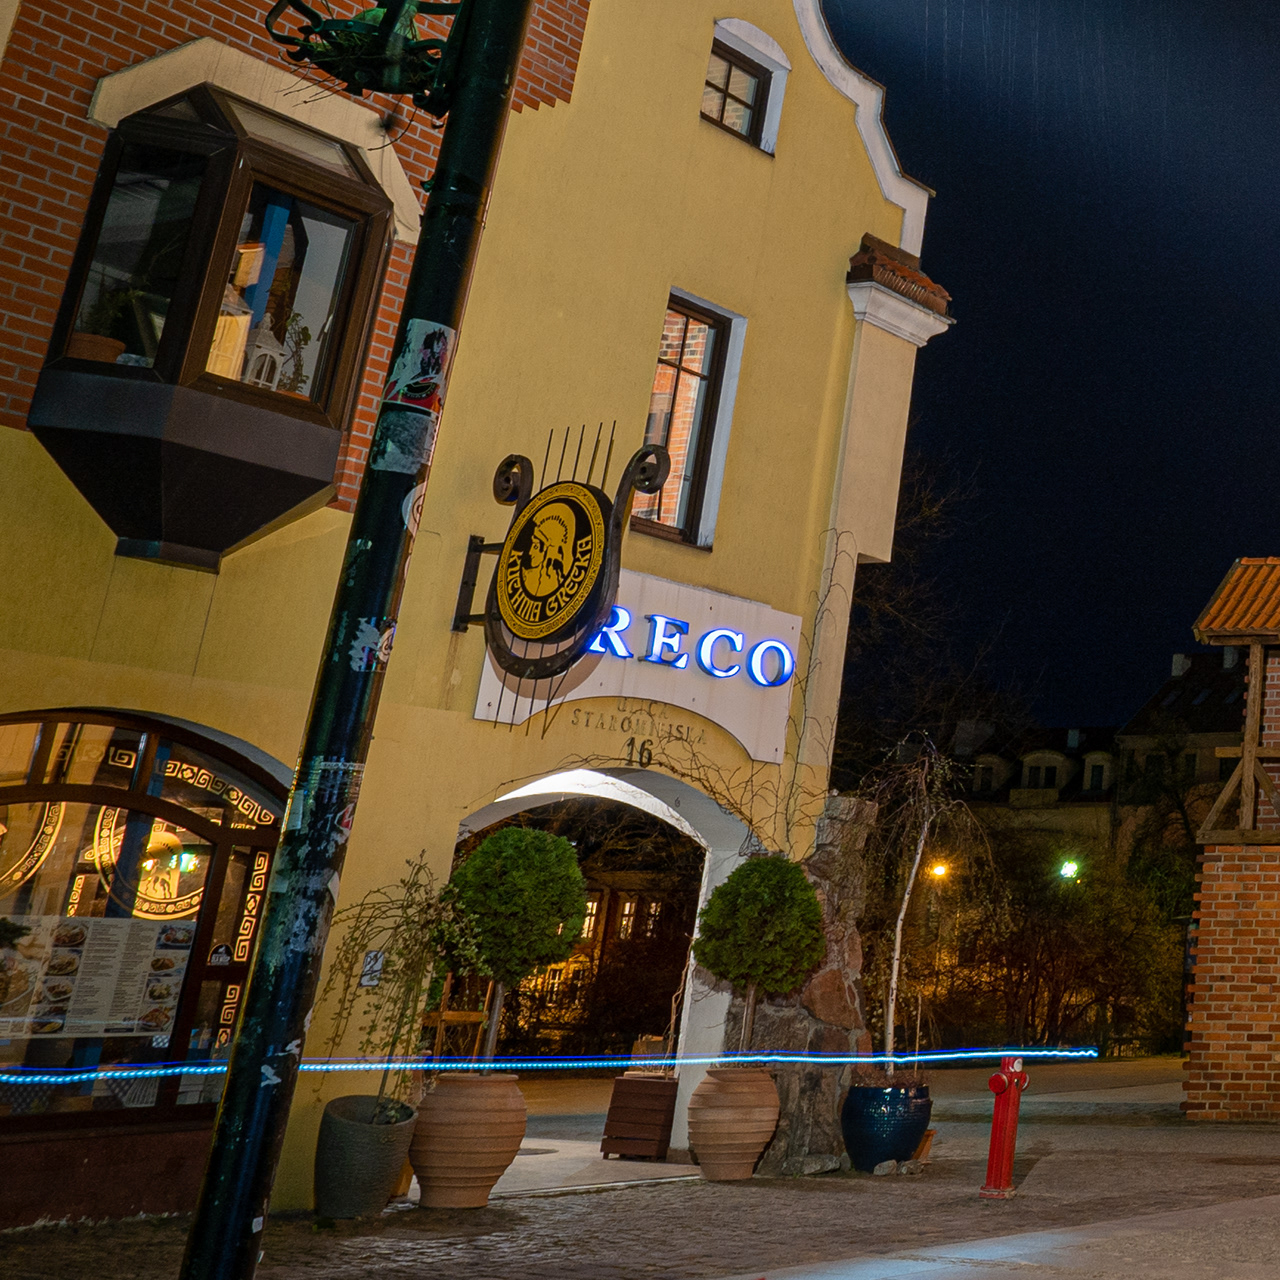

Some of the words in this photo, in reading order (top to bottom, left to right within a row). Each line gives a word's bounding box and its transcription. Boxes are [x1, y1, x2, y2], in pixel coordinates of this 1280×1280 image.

[545, 534, 592, 617] GRECKA
[585, 605, 796, 688] RECO
[624, 736, 654, 769] 16
